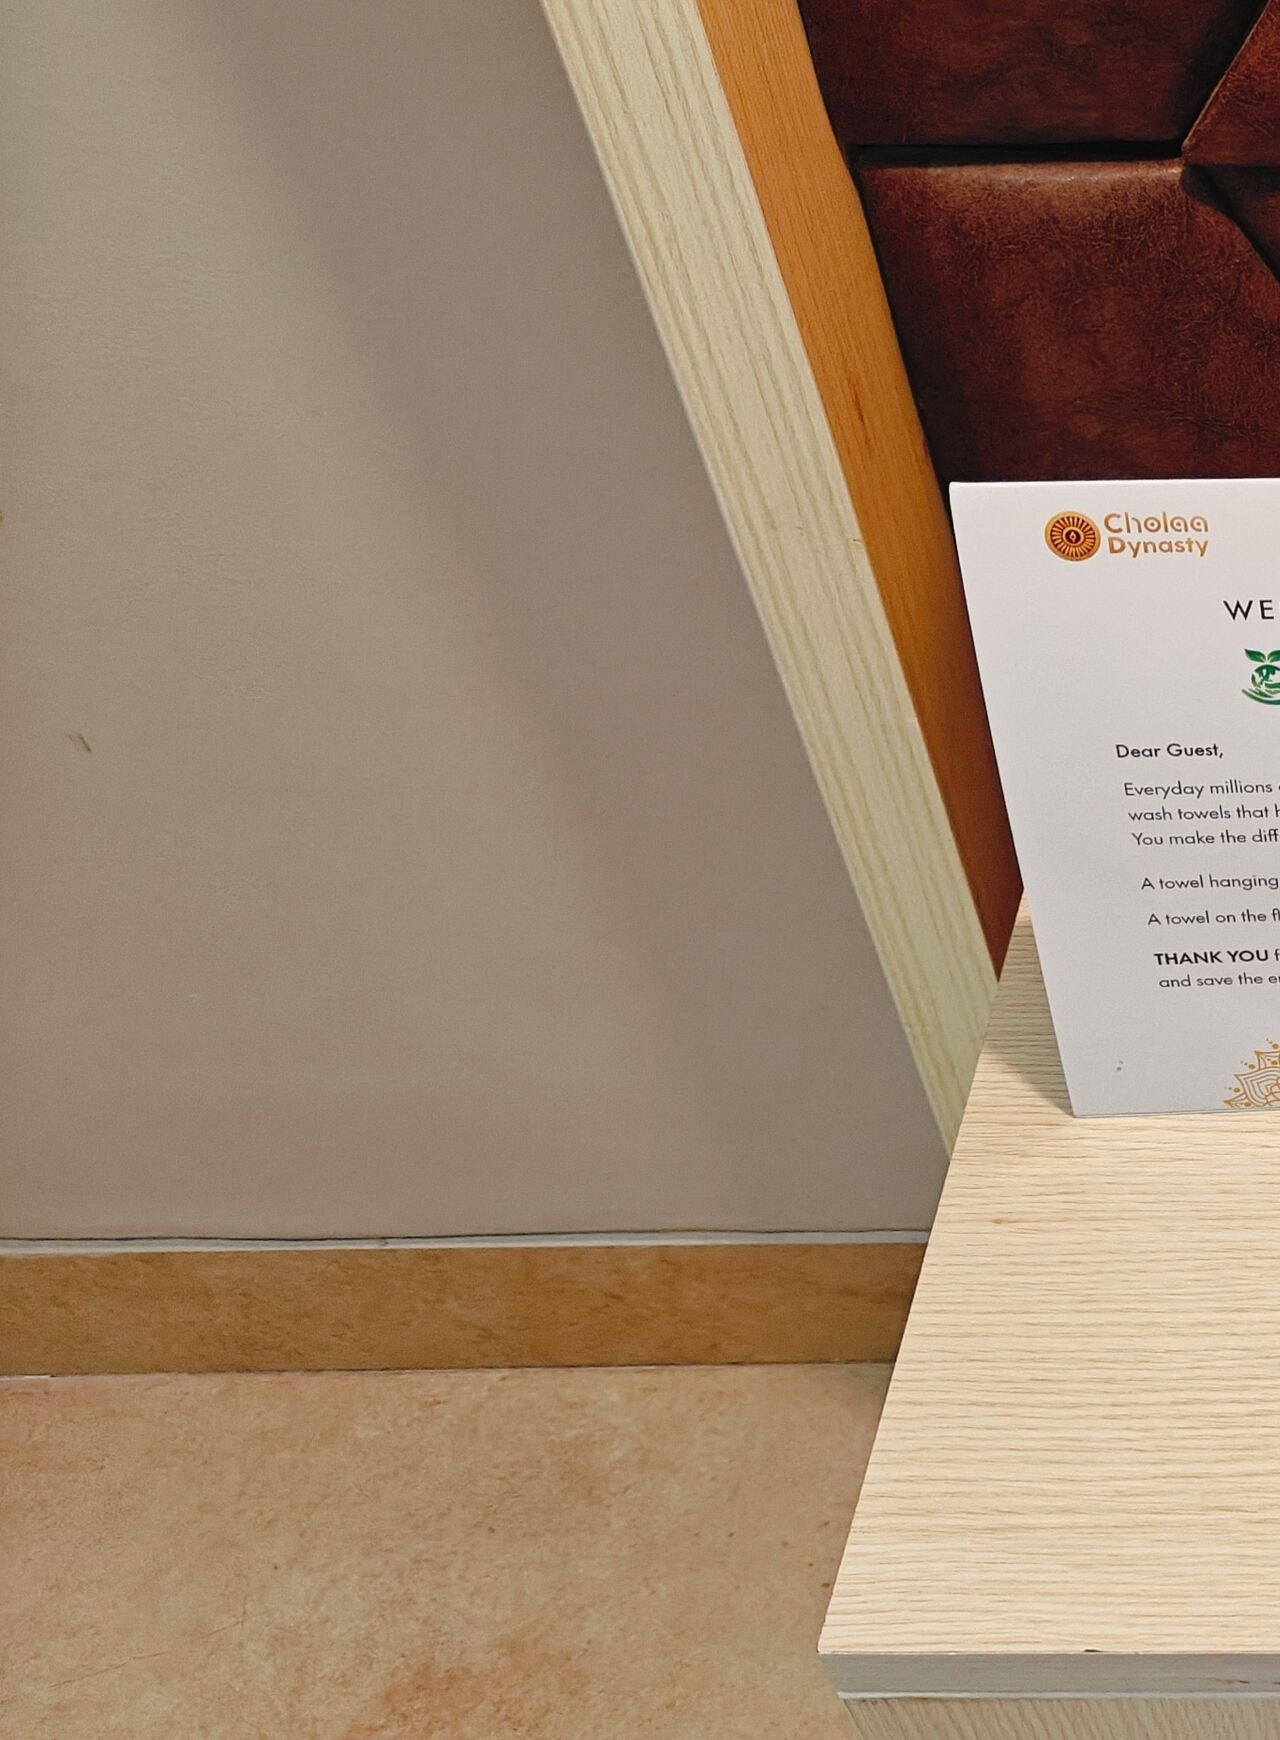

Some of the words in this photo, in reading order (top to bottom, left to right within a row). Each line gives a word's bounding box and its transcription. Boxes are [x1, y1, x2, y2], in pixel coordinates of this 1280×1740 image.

[1103, 511, 1209, 534] Cholaa
[1107, 536, 1209, 559] Dynasty
[1114, 743, 1162, 759] Dear
[1166, 742, 1224, 760] Guest,
[1123, 779, 1205, 801] Everyday
[1209, 778, 1274, 795] millions
[1127, 805, 1173, 822] wash
[1177, 803, 1232, 821] towels
[1235, 803, 1270, 820] that
[1130, 831, 1164, 846] You
[1168, 829, 1216, 846] make
[1219, 828, 1247, 844] the
[1140, 876, 1156, 891] A
[1158, 873, 1205, 890] towel
[1208, 873, 1279, 892] hanging
[1147, 912, 1162, 926] A
[1165, 909, 1211, 926] towel
[1215, 913, 1237, 924] on
[1240, 908, 1267, 923] the
[1152, 950, 1224, 966] THANK
[1225, 948, 1269, 964] YOU
[1158, 973, 1192, 988] and
[1196, 976, 1234, 987] save
[1237, 971, 1264, 986] the
